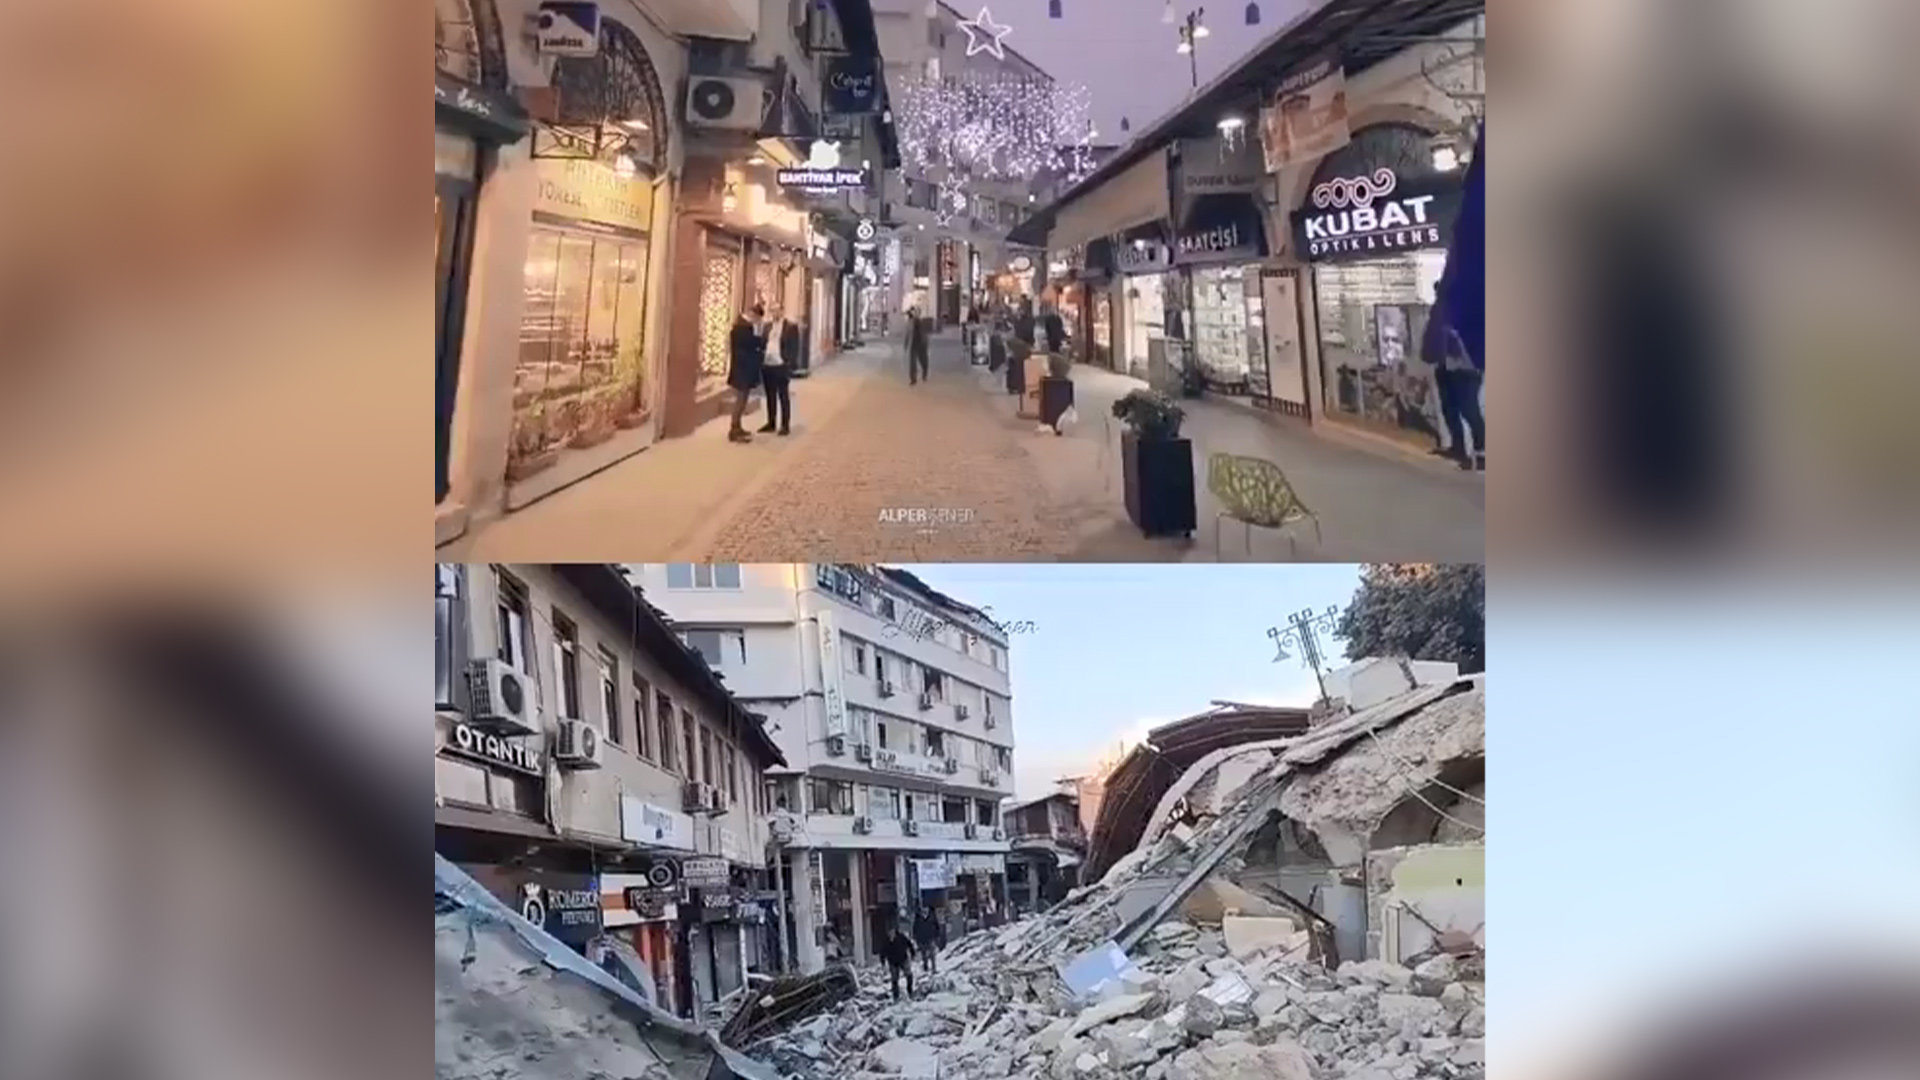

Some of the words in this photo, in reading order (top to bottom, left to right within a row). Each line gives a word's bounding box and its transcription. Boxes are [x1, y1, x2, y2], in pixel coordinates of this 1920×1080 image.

[1305, 195, 1434, 240] KUBAT
[1382, 227, 1439, 248] LENS
[456, 724, 542, 772] OTANTIK
